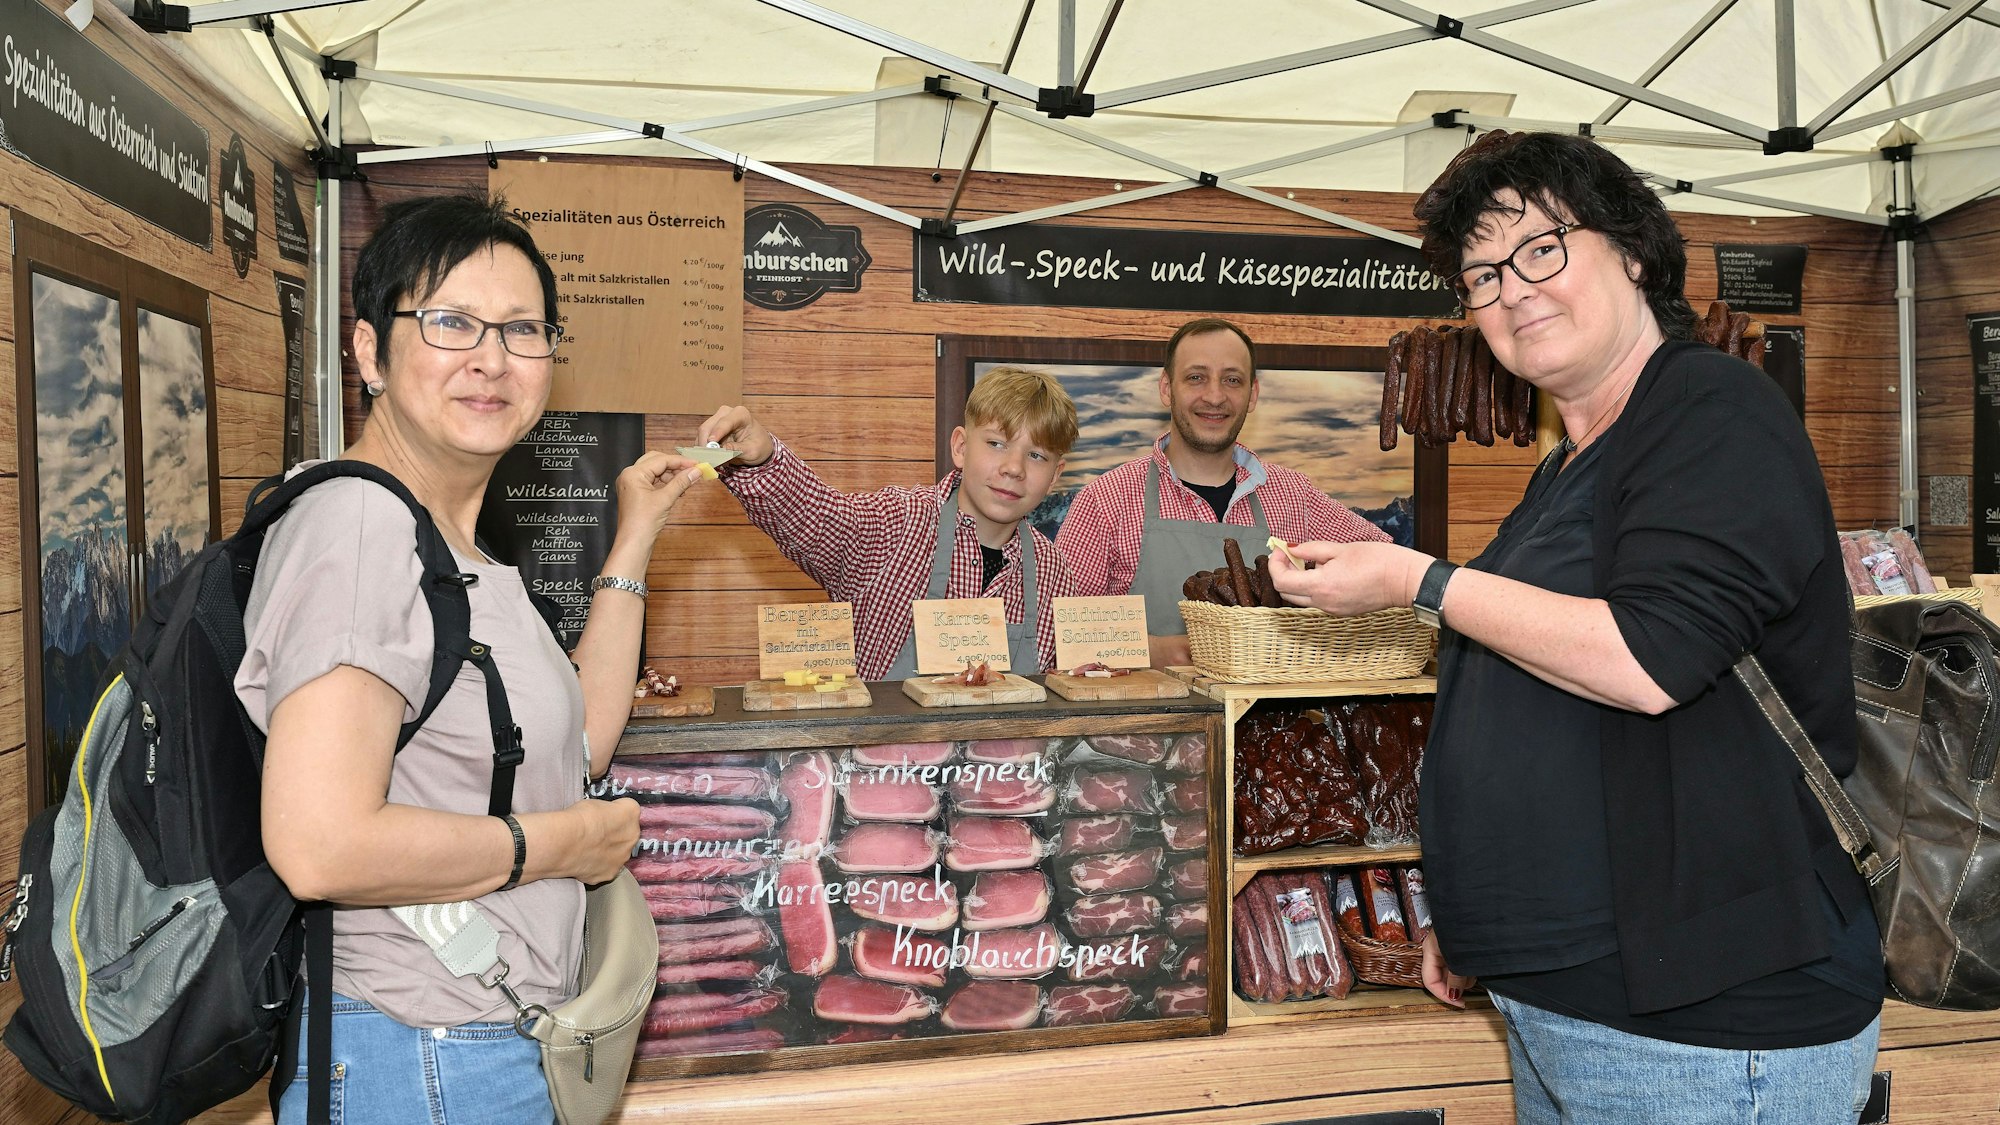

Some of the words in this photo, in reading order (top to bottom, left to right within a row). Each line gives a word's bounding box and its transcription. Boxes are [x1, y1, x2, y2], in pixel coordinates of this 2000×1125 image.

[5, 34, 86, 127] Spezialitäten
[88, 101, 107, 142] aus
[109, 95, 158, 172] Österreich
[160, 142, 177, 184] und
[178, 151, 209, 205] Südtirol
[512, 208, 613, 225] Spezialitäten
[617, 214, 643, 226] aus
[647, 211, 726, 230] Österreich
[560, 251, 585, 263] jung
[744, 250, 849, 273] mburschen
[561, 273, 575, 282] alt
[578, 273, 597, 283] mit
[599, 273, 670, 285] Salzkristallen
[756, 275, 804, 283] FEINKOST
[1150, 252, 1206, 283] und
[1218, 256, 1450, 296] Käsespezialitäten
[573, 294, 645, 306] Salzkristallen
[543, 420, 571, 429] REh
[535, 445, 580, 455] Lamm
[541, 457, 573, 468] Rind
[506, 484, 609, 498] Wildsalami
[516, 513, 599, 524] Wildschwein
[545, 526, 571, 536] Reh
[532, 539, 584, 549] Mufflon
[539, 552, 577, 562] Gams
[532, 577, 584, 596] Speck
[763, 604, 851, 626] Bergkäse
[933, 611, 991, 627] Karree
[1057, 605, 1144, 623] Südtiroler
[797, 626, 819, 639] mit
[1062, 626, 1142, 644] Schinken
[765, 640, 851, 654] Salzkristallen
[938, 631, 990, 651] Speck
[957, 653, 1008, 664] 4,90€/100g
[1096, 648, 1148, 658] 4,90€/100g
[803, 658, 857, 668] 4,90€/100g
[753, 864, 951, 915] Karreespeck
[891, 923, 1150, 978] Knoblauchspeck
